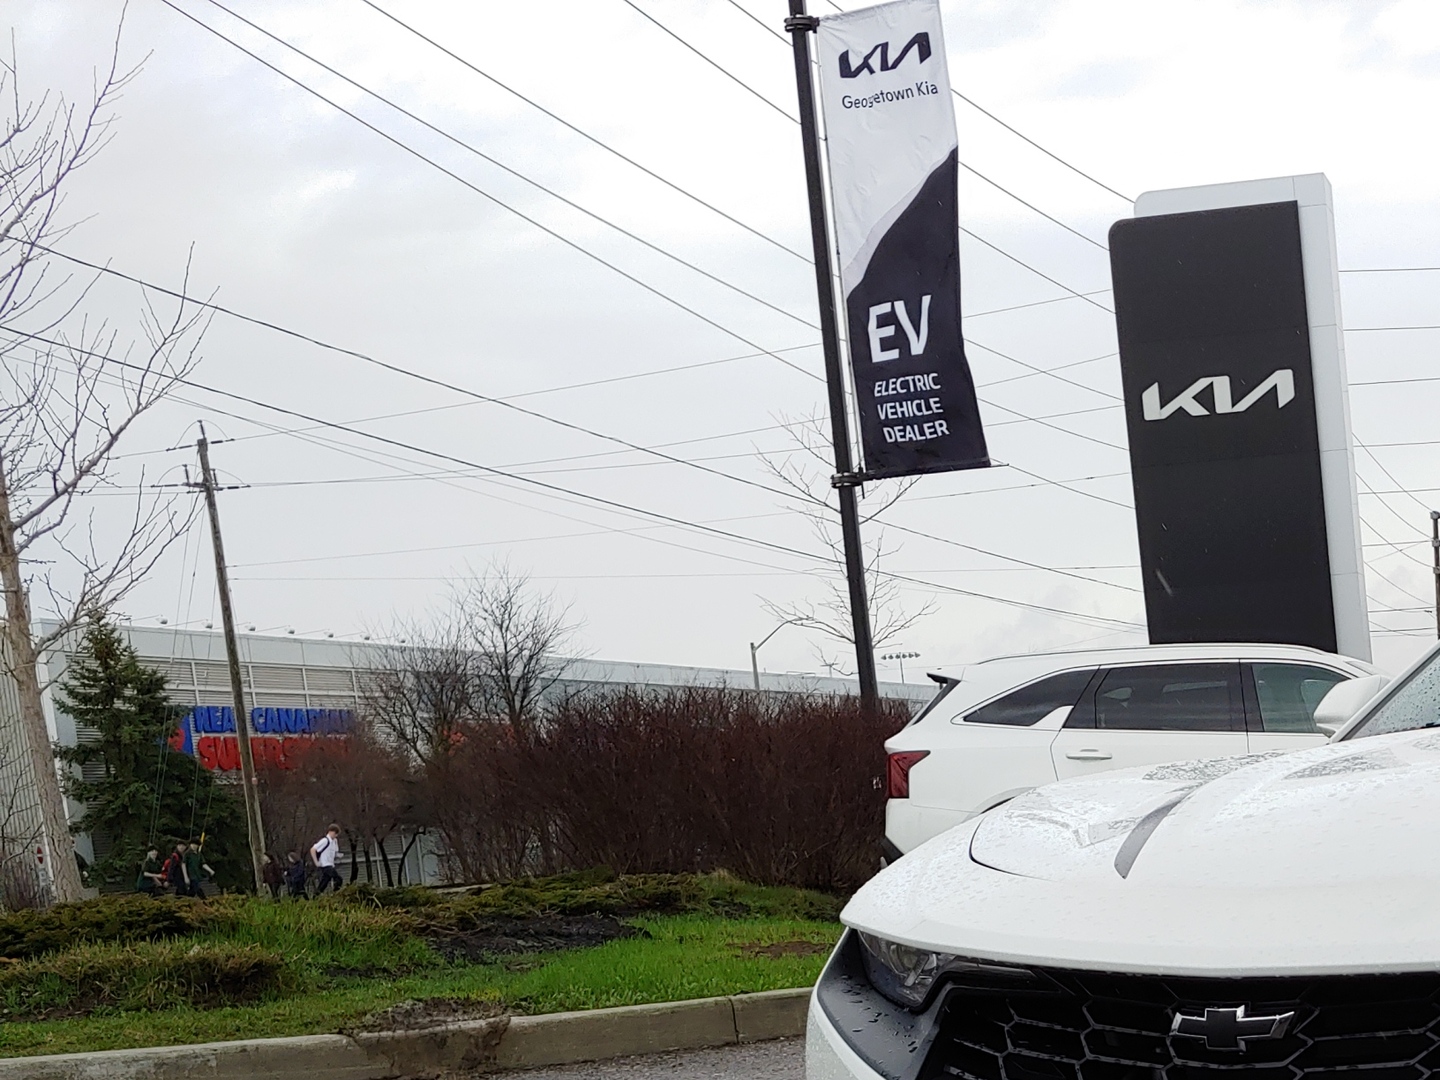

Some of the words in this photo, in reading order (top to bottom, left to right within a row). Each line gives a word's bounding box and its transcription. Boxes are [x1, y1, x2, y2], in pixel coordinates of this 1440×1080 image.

[838, 32, 932, 78] KIA
[915, 81, 938, 97] Kia
[868, 295, 931, 363] EV
[874, 373, 941, 397] ELECTRIC
[1142, 369, 1295, 421] KIA
[877, 398, 943, 420] VEHICLE
[883, 420, 949, 443] DEALER
[194, 706, 242, 733] REA
